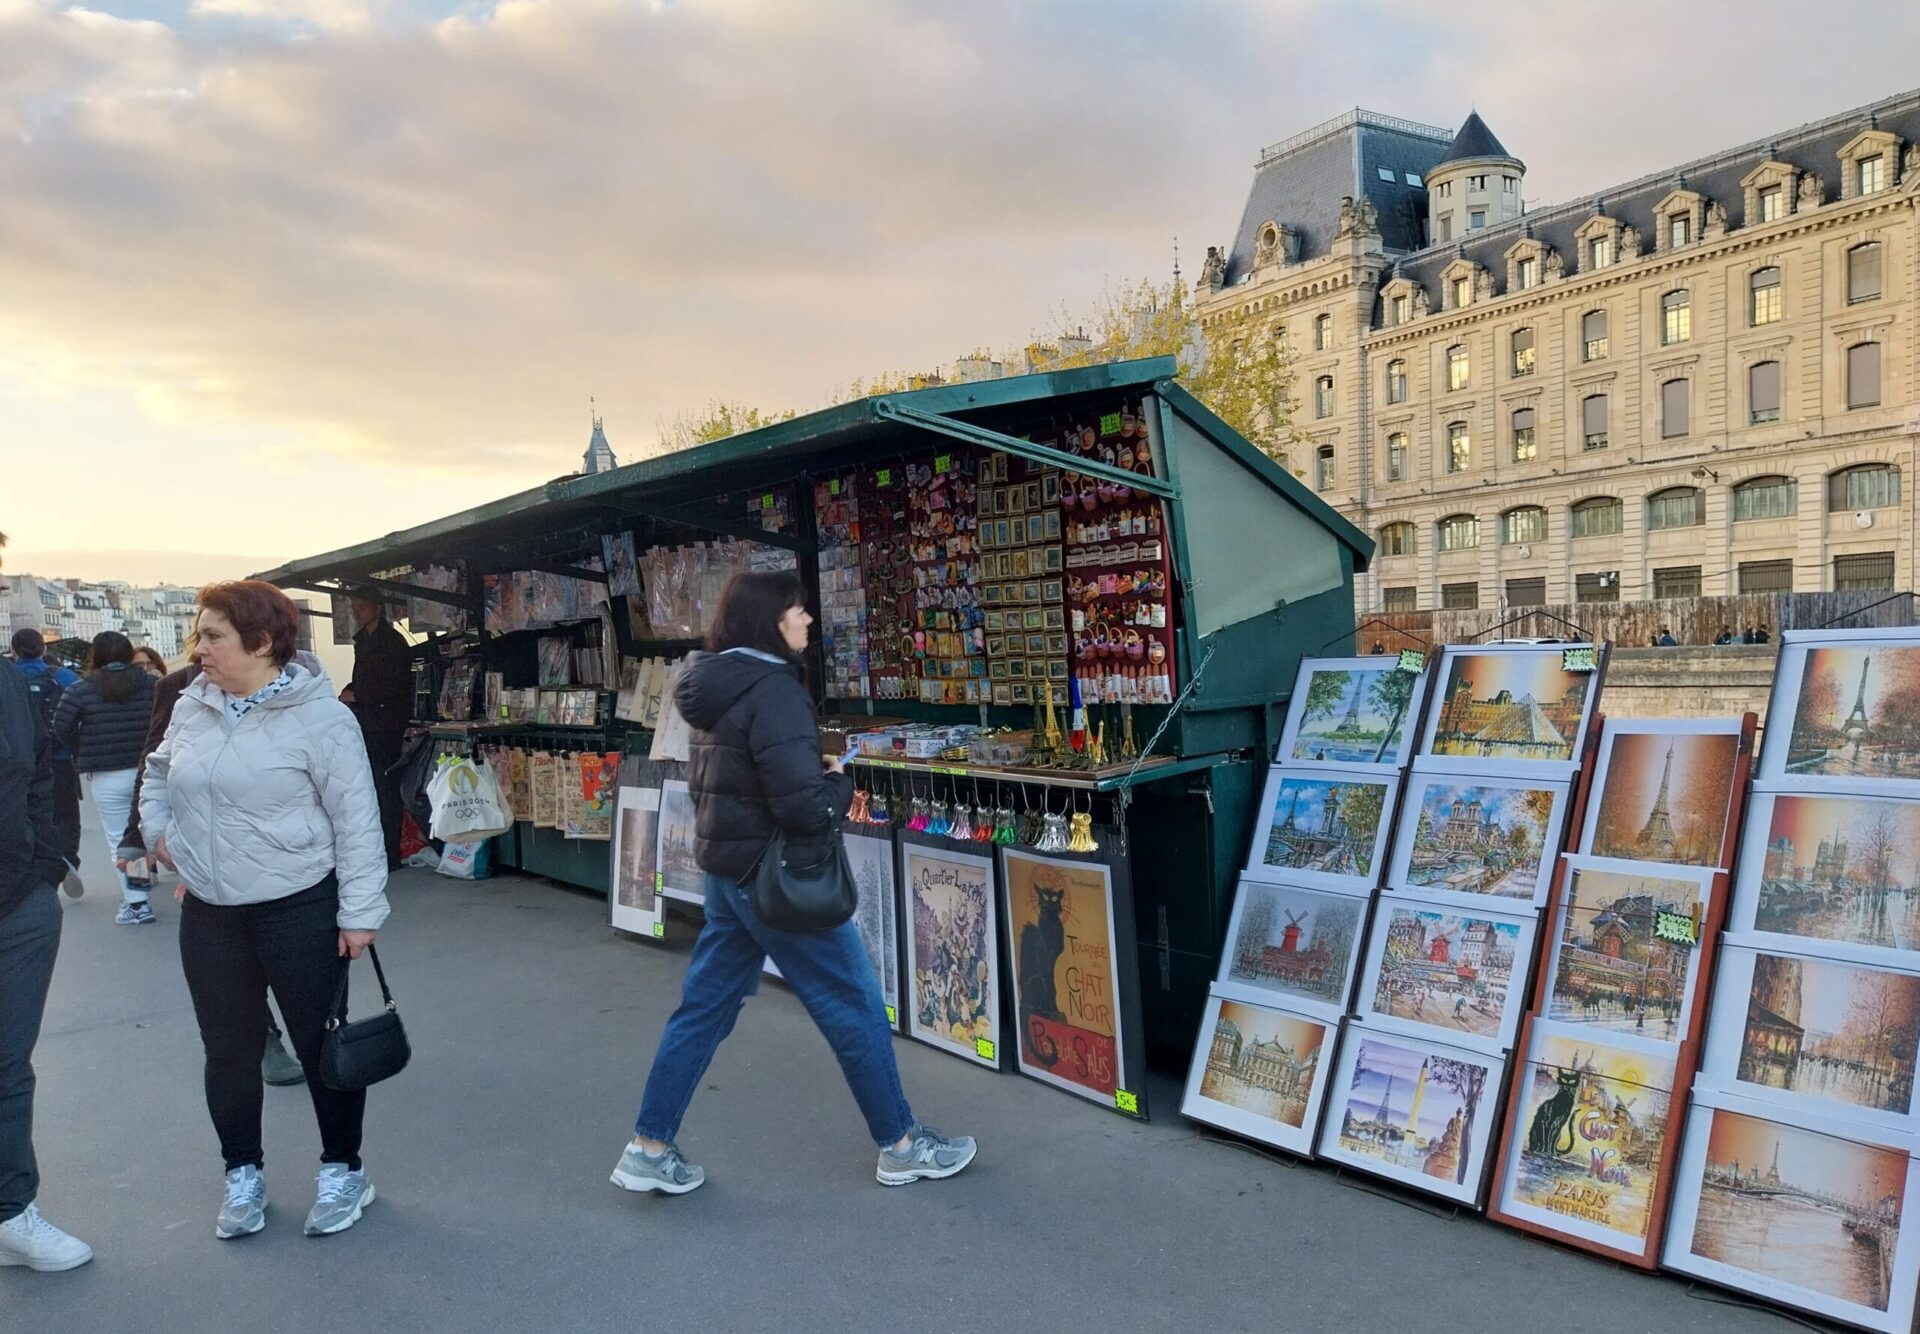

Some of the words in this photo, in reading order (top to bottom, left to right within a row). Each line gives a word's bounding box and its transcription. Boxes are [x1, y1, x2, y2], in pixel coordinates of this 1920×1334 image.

[442, 800, 467, 809] PARIS
[922, 868, 954, 891] Quartier
[1066, 967, 1104, 1004] CHAT
[1069, 992, 1112, 1031] NOIR
